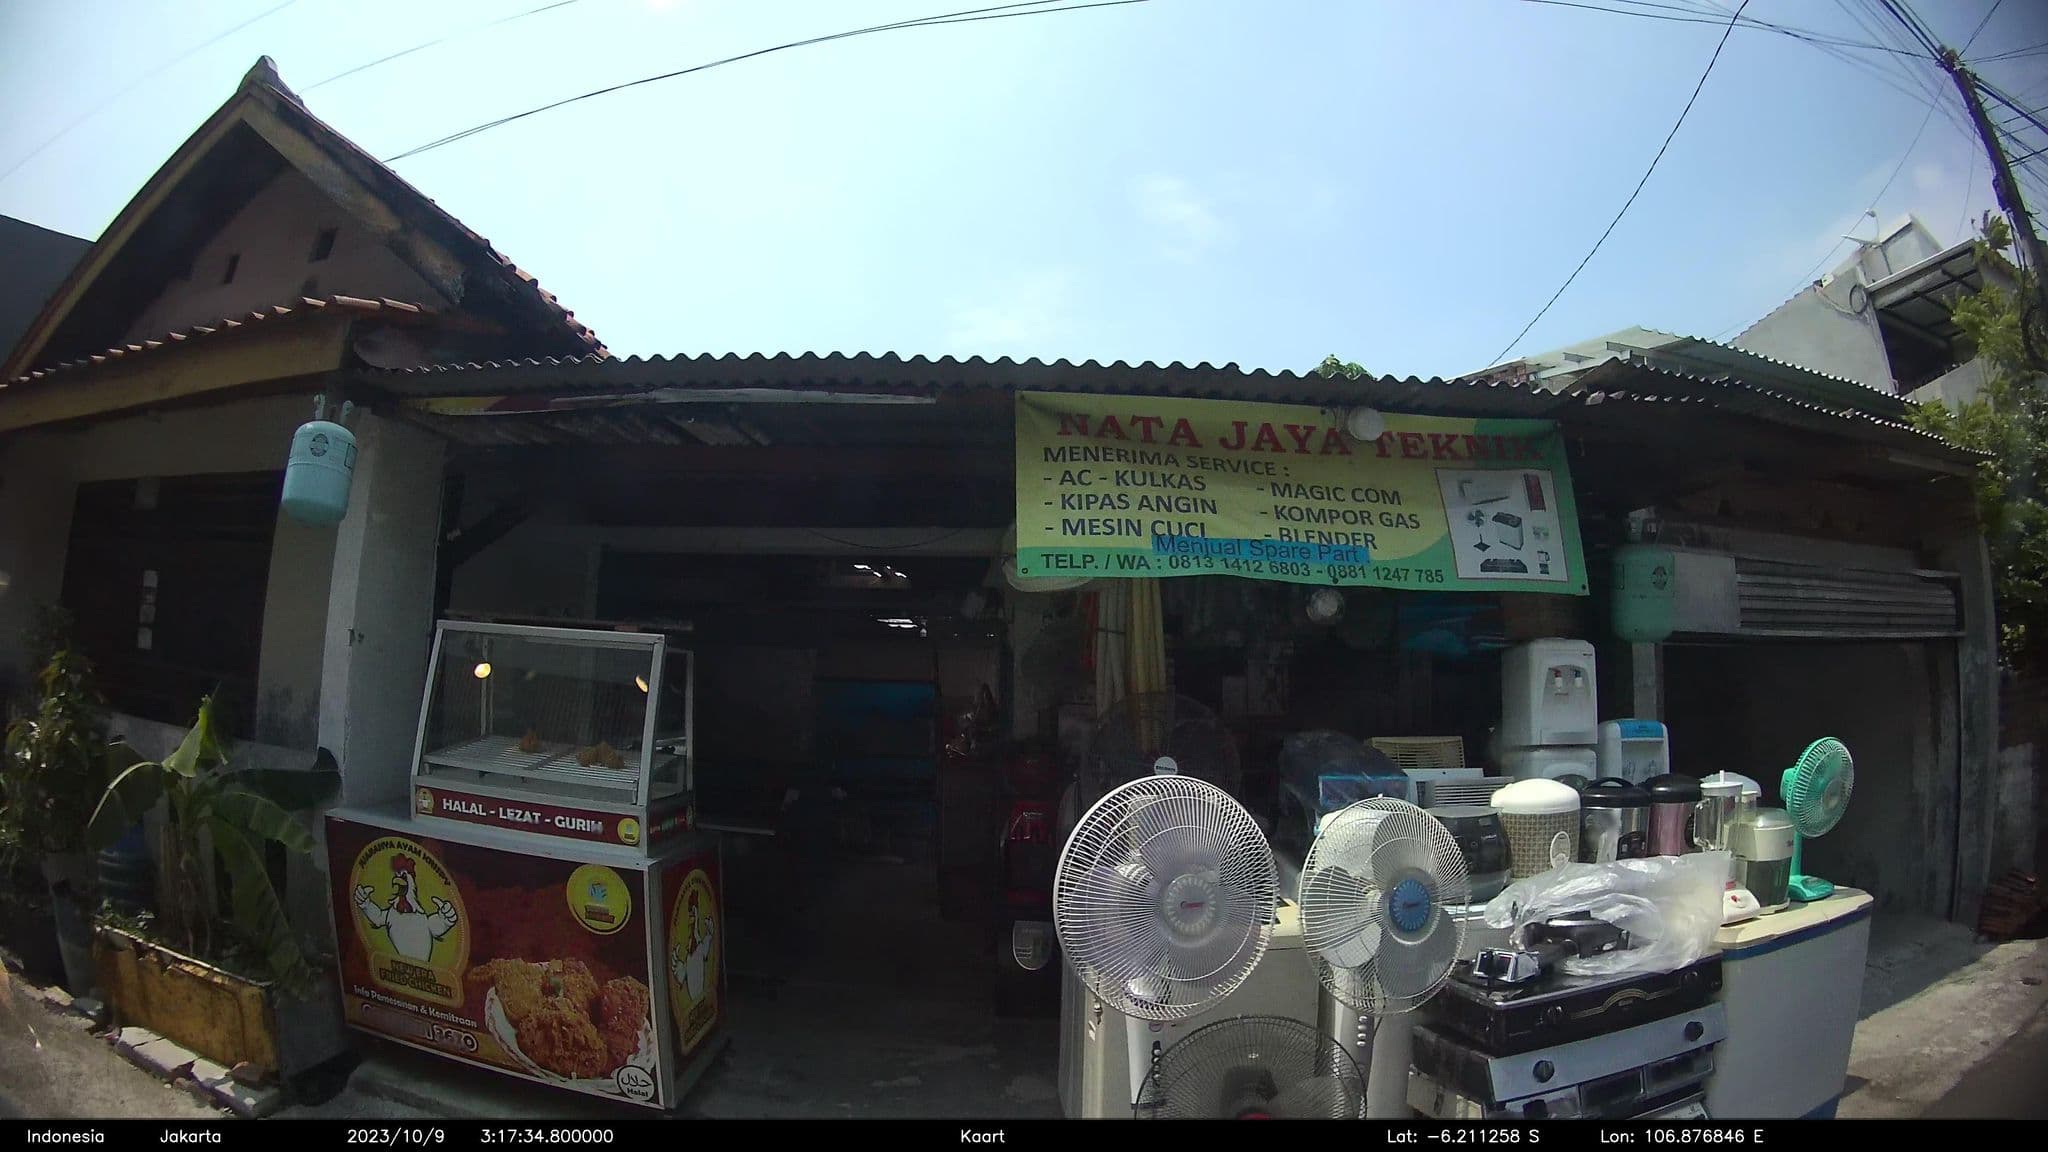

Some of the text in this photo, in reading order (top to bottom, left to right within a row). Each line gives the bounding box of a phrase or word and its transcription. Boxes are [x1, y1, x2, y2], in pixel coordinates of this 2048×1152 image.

[1057, 413, 1545, 461] NATA JAYA TEKNIK
[1043, 446, 1180, 468] MENERIMA
[1187, 455, 1276, 476] SERVICE
[1059, 469, 1092, 486] AC
[1114, 469, 1207, 492] KULKAS
[1061, 493, 1131, 511] KIPAS
[1137, 495, 1218, 515] ANGIN
[1271, 482, 1346, 503] MAGIC
[1351, 487, 1402, 506] COM
[1062, 518, 1142, 537] MESIN
[1151, 520, 1206, 538] CUCI
[1274, 505, 1374, 527] KOMPOR
[1379, 511, 1421, 530] GAS
[1156, 536, 1361, 563] Menjual Spare Part
[1279, 527, 1378, 550] BLENDER
[1041, 553, 1098, 570] TELP.
[1116, 554, 1151, 570] WA
[1169, 555, 1214, 570] 0813
[1221, 558, 1263, 573] 1412
[1269, 561, 1310, 577] 6803
[1327, 566, 1366, 580] 0881
[1373, 567, 1408, 582] 1247
[1414, 569, 1445, 583] 785
[442, 798, 486, 817] HALAL
[499, 807, 542, 825] LEZAT
[627, 1088, 649, 1097] Halal
